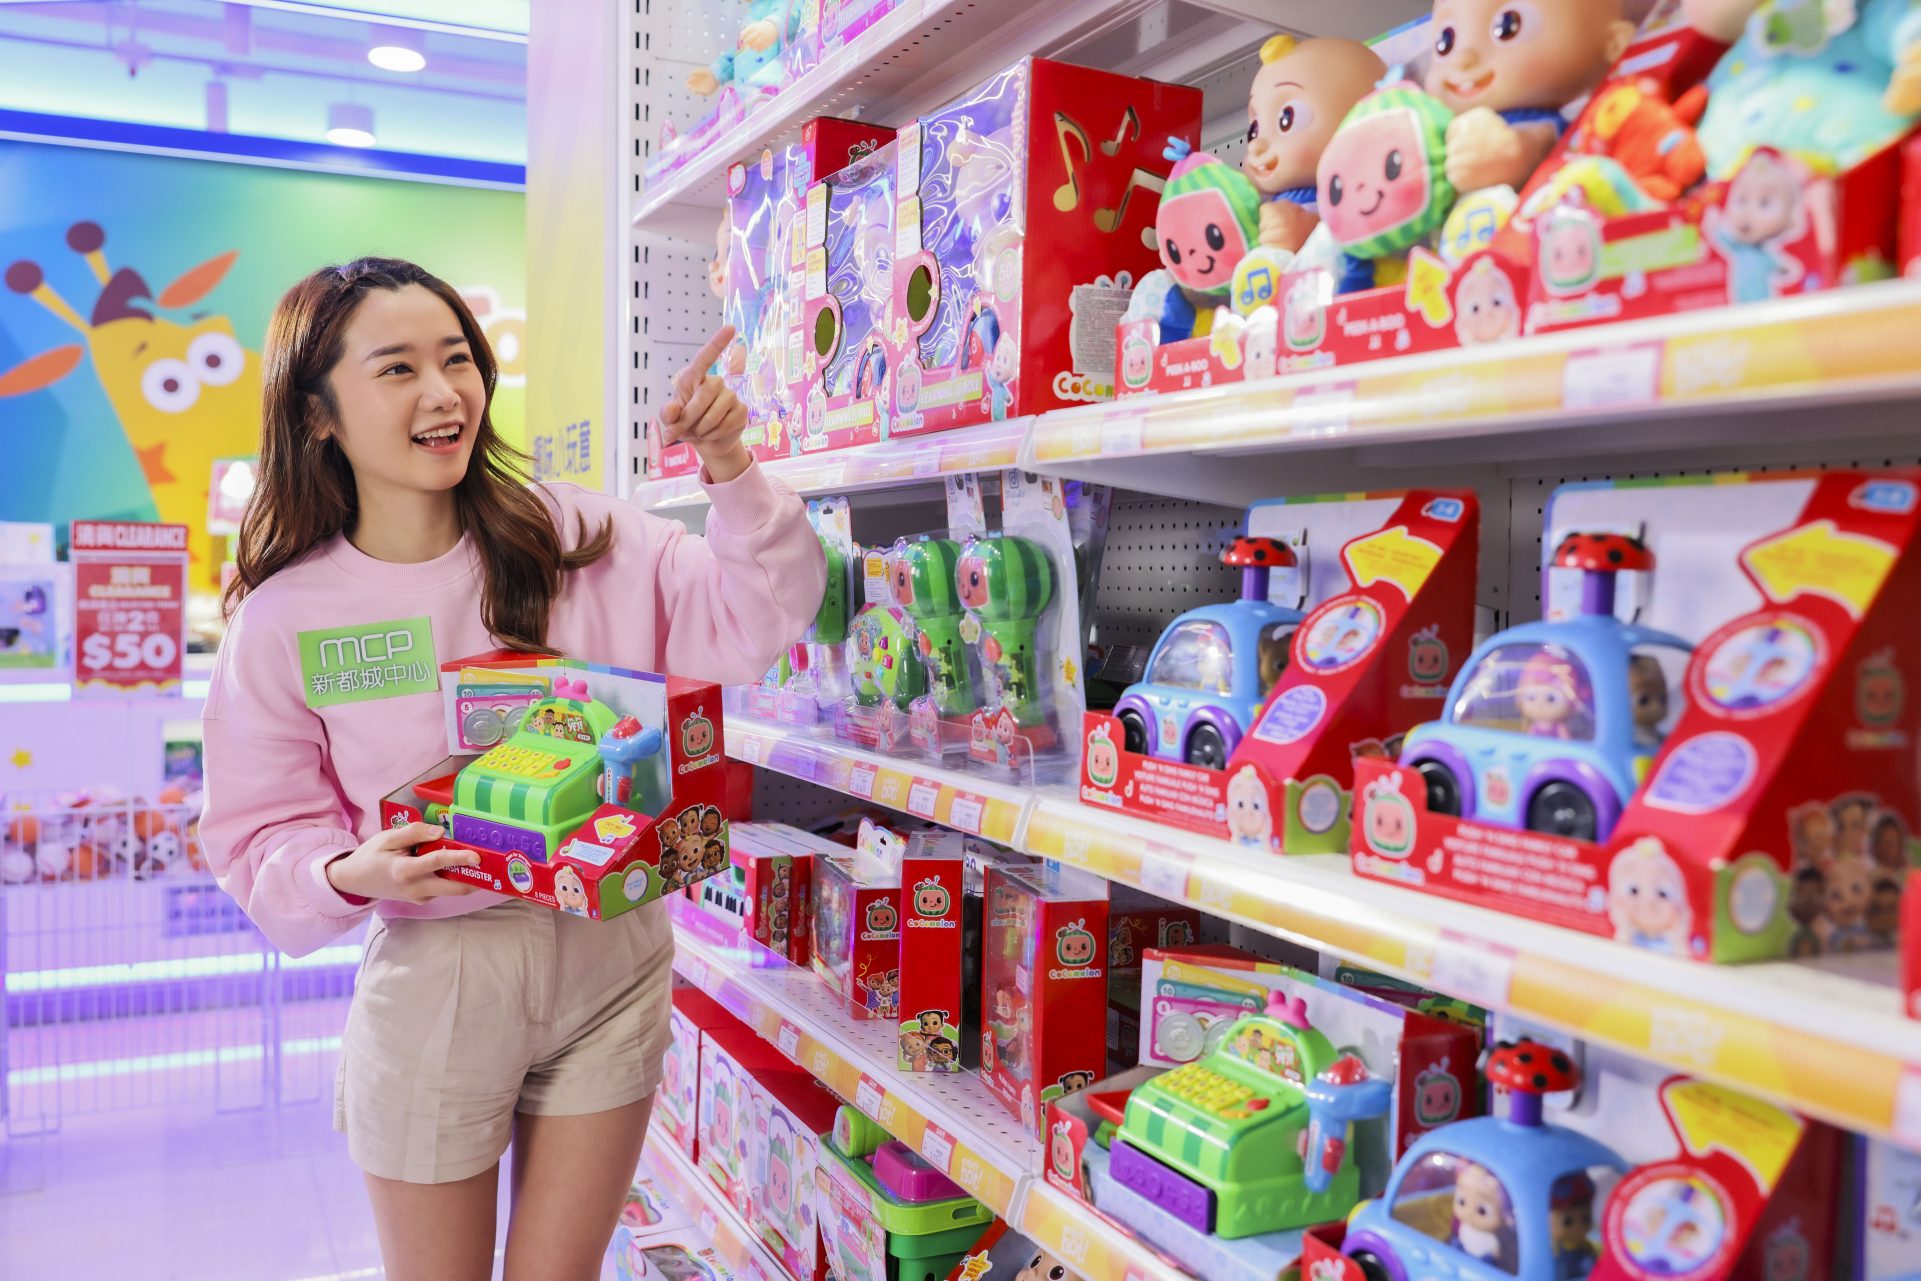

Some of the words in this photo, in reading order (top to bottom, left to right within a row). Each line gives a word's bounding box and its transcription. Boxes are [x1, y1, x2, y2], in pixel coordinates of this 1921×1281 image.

[82, 632, 177, 670] $50
[311, 660, 431, 696] 新都城中心
[461, 867, 493, 883] REGISTER
[539, 892, 556, 903] PIECES
[907, 918, 956, 929] CoComelon
[861, 931, 900, 941] CoComelon
[1048, 967, 1102, 980] CoComelon
[1163, 987, 1173, 996] 10
